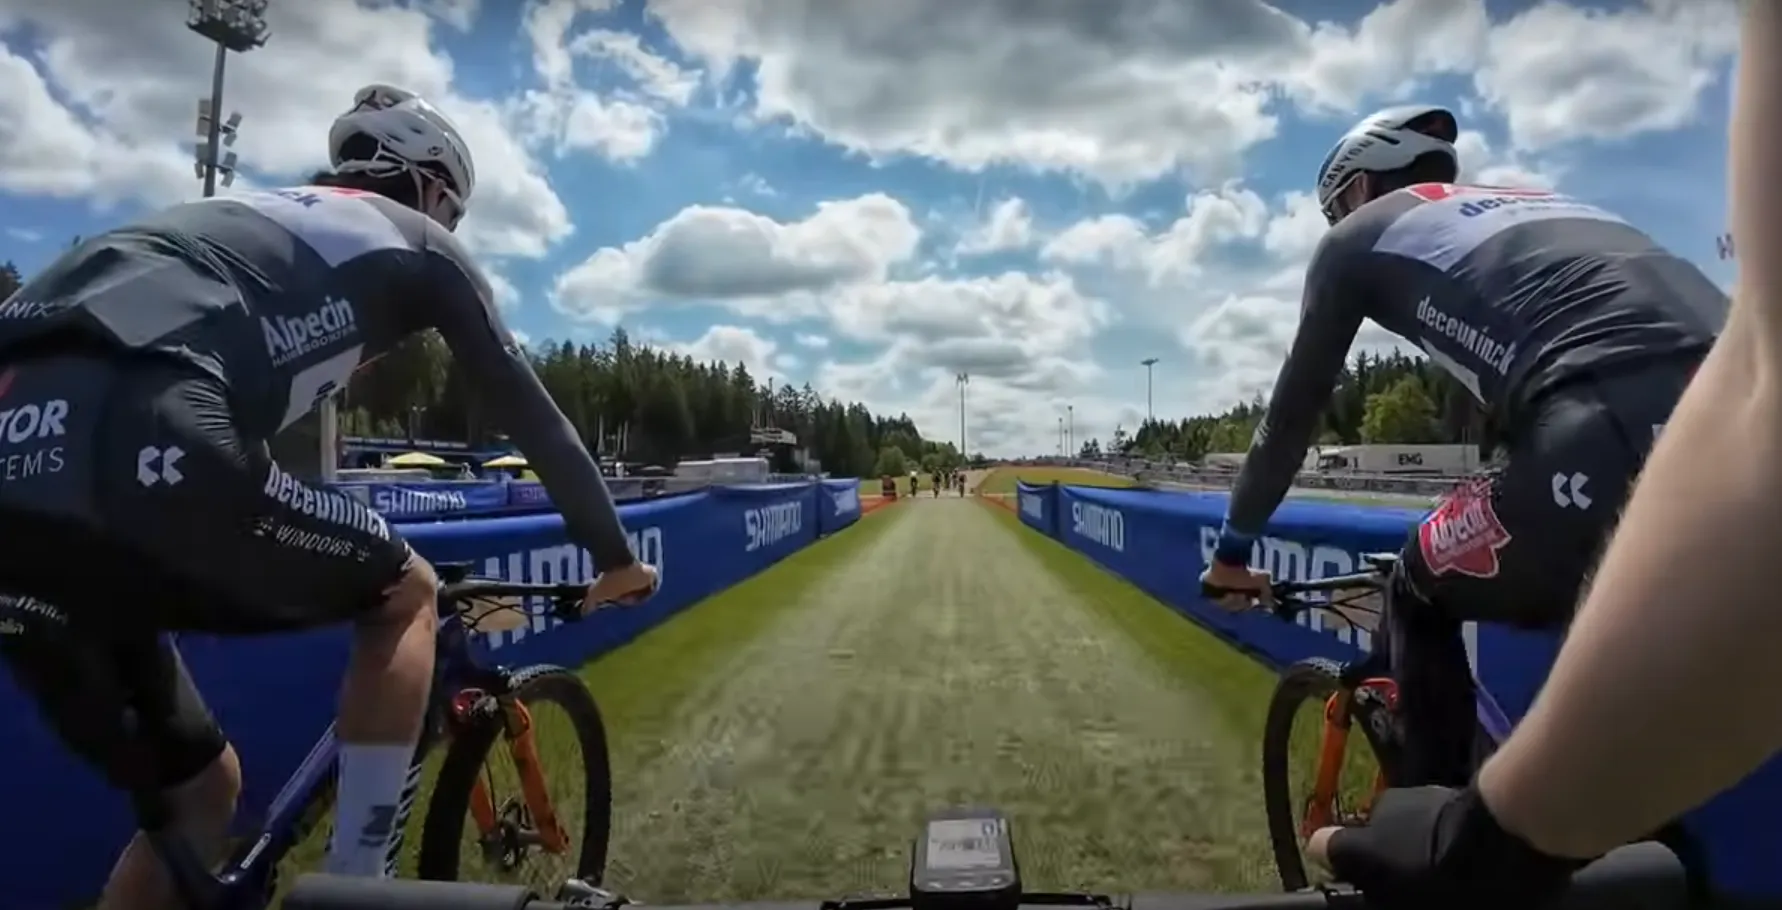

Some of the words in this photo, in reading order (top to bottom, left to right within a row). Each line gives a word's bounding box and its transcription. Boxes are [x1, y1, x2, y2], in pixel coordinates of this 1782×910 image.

[1322, 139, 1375, 188] CANYON
[0, 302, 55, 318] NIX
[259, 295, 355, 356] Alpecin
[1416, 295, 1517, 376] deceuninck
[276, 523, 353, 557] WINDOWS
[745, 501, 802, 551] SHIMANO
[1072, 501, 1124, 552] SHIMANO
